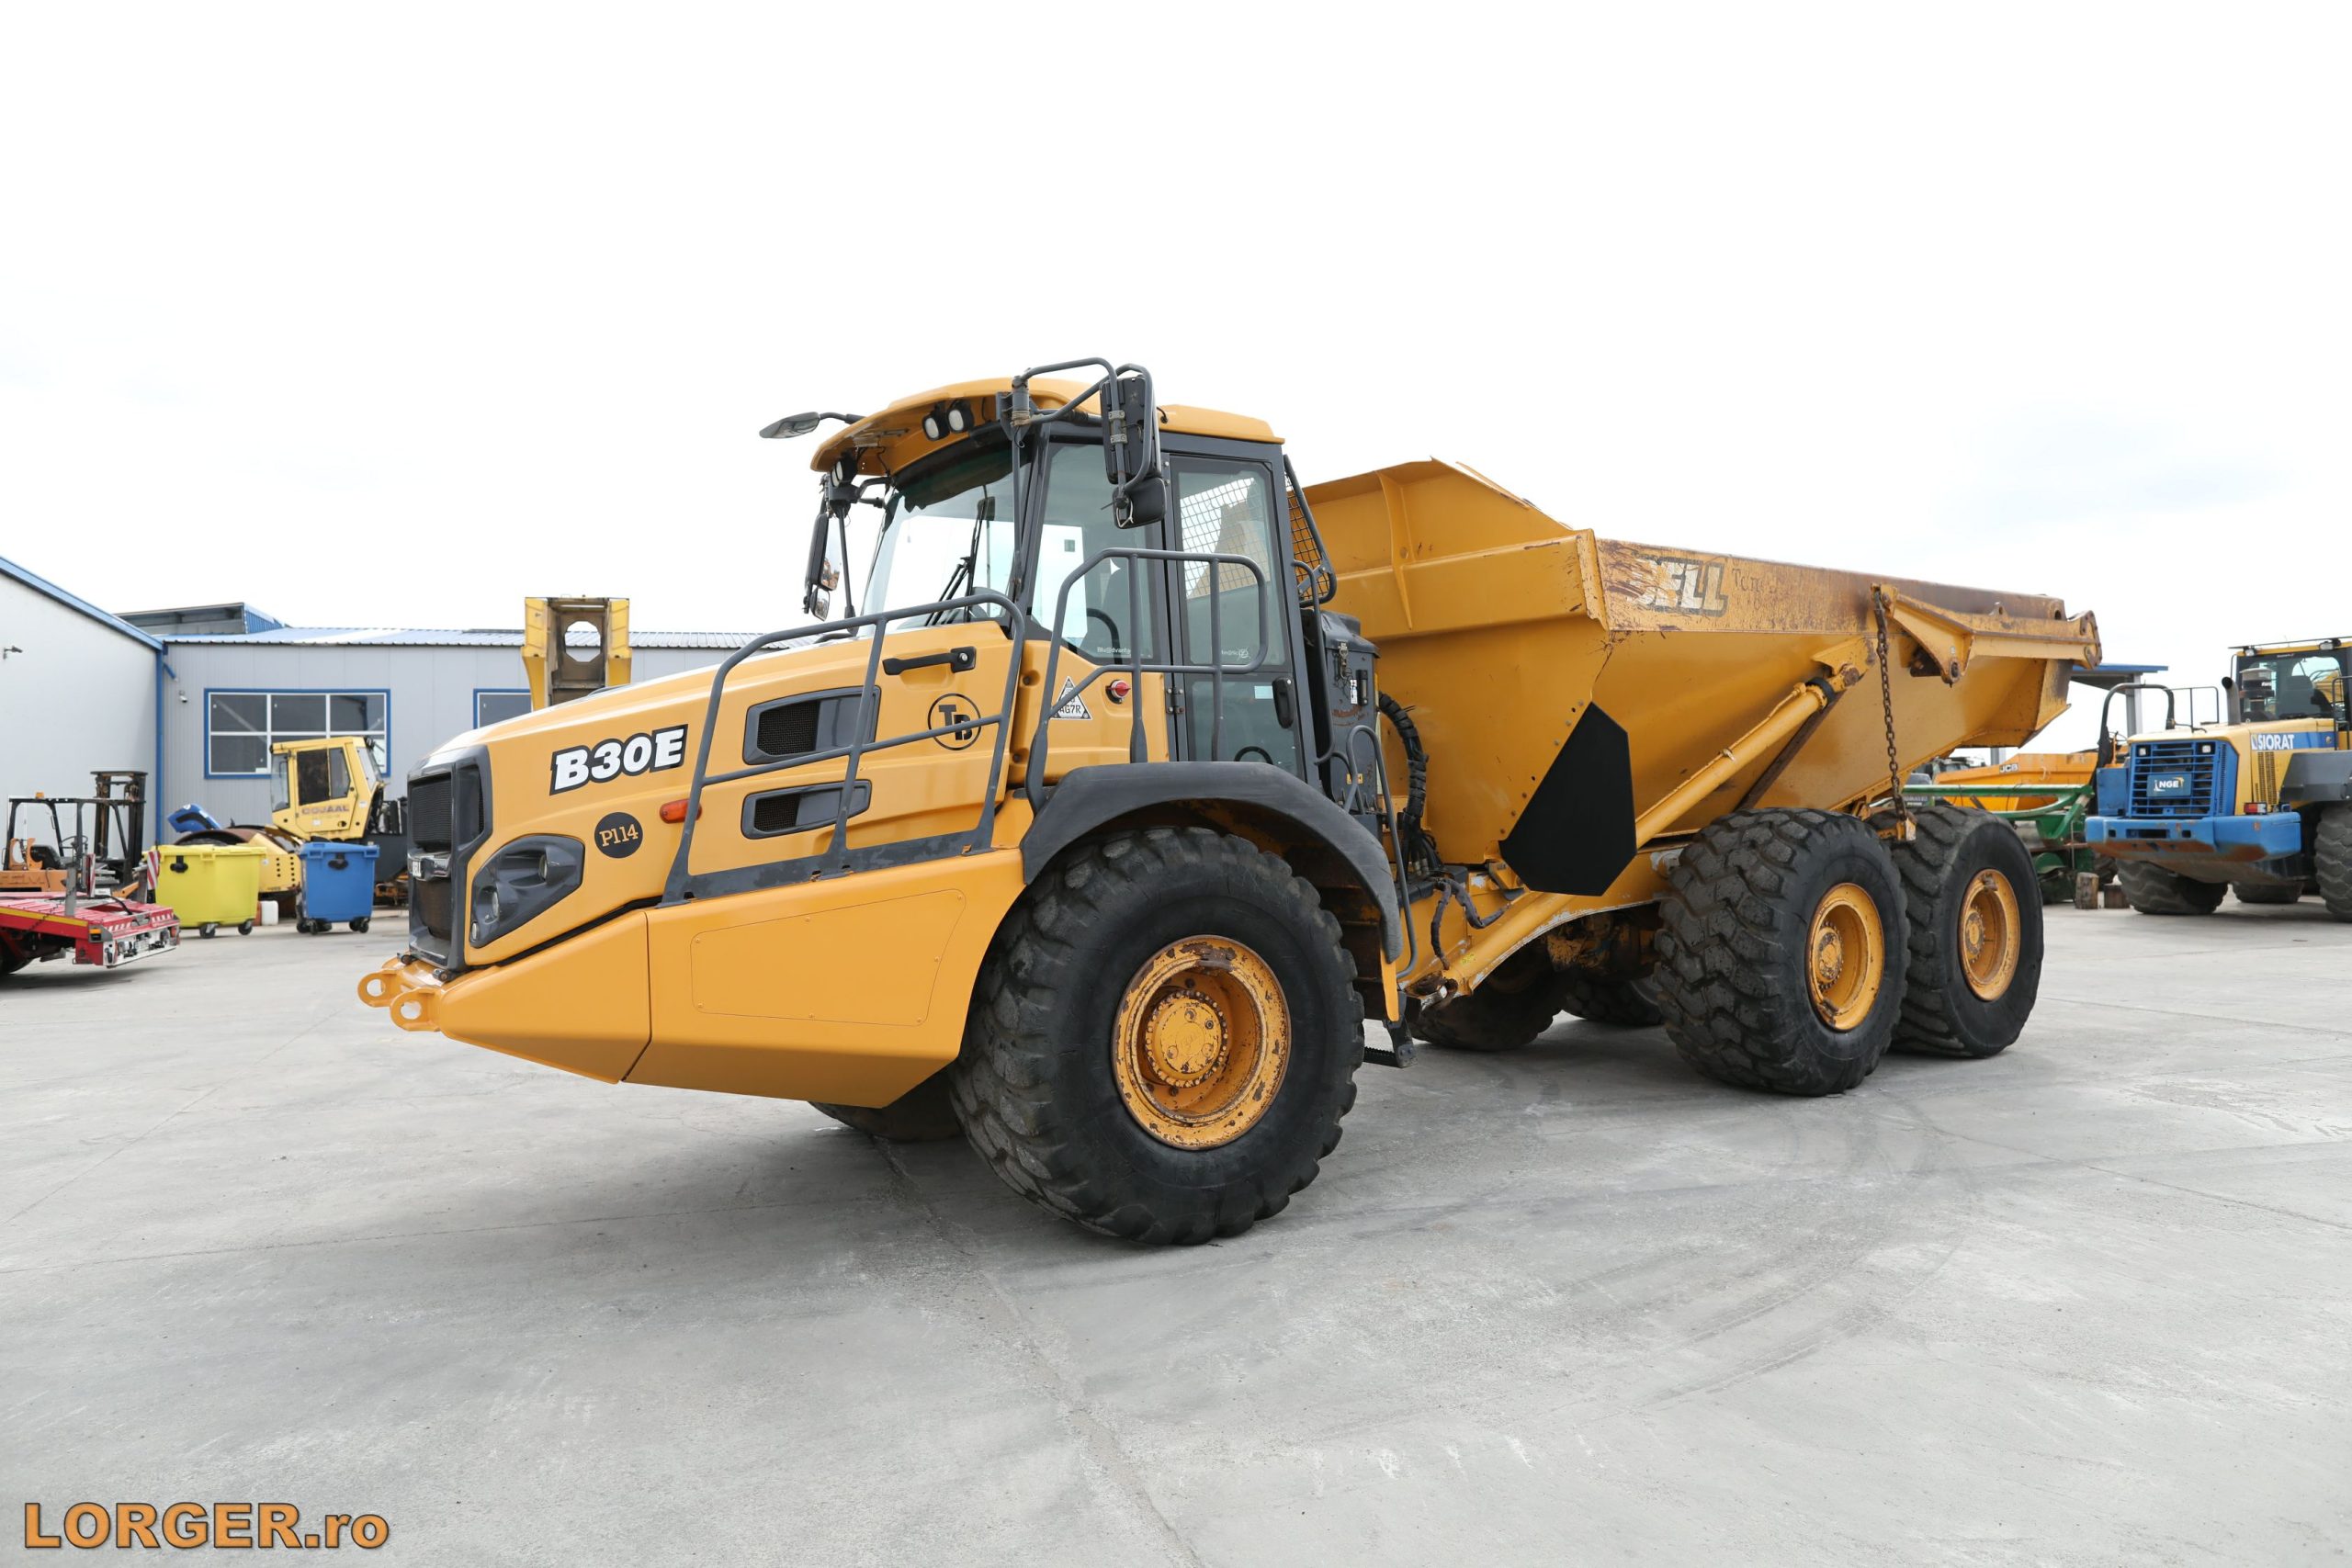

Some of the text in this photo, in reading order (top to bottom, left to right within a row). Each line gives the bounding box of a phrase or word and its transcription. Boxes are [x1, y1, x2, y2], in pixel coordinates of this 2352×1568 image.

[1059, 705, 1081, 714] AG7R
[2257, 734, 2295, 750] SIORAT
[549, 724, 688, 795] B30E
[1998, 763, 2019, 773] JCB
[599, 824, 639, 847] P114
